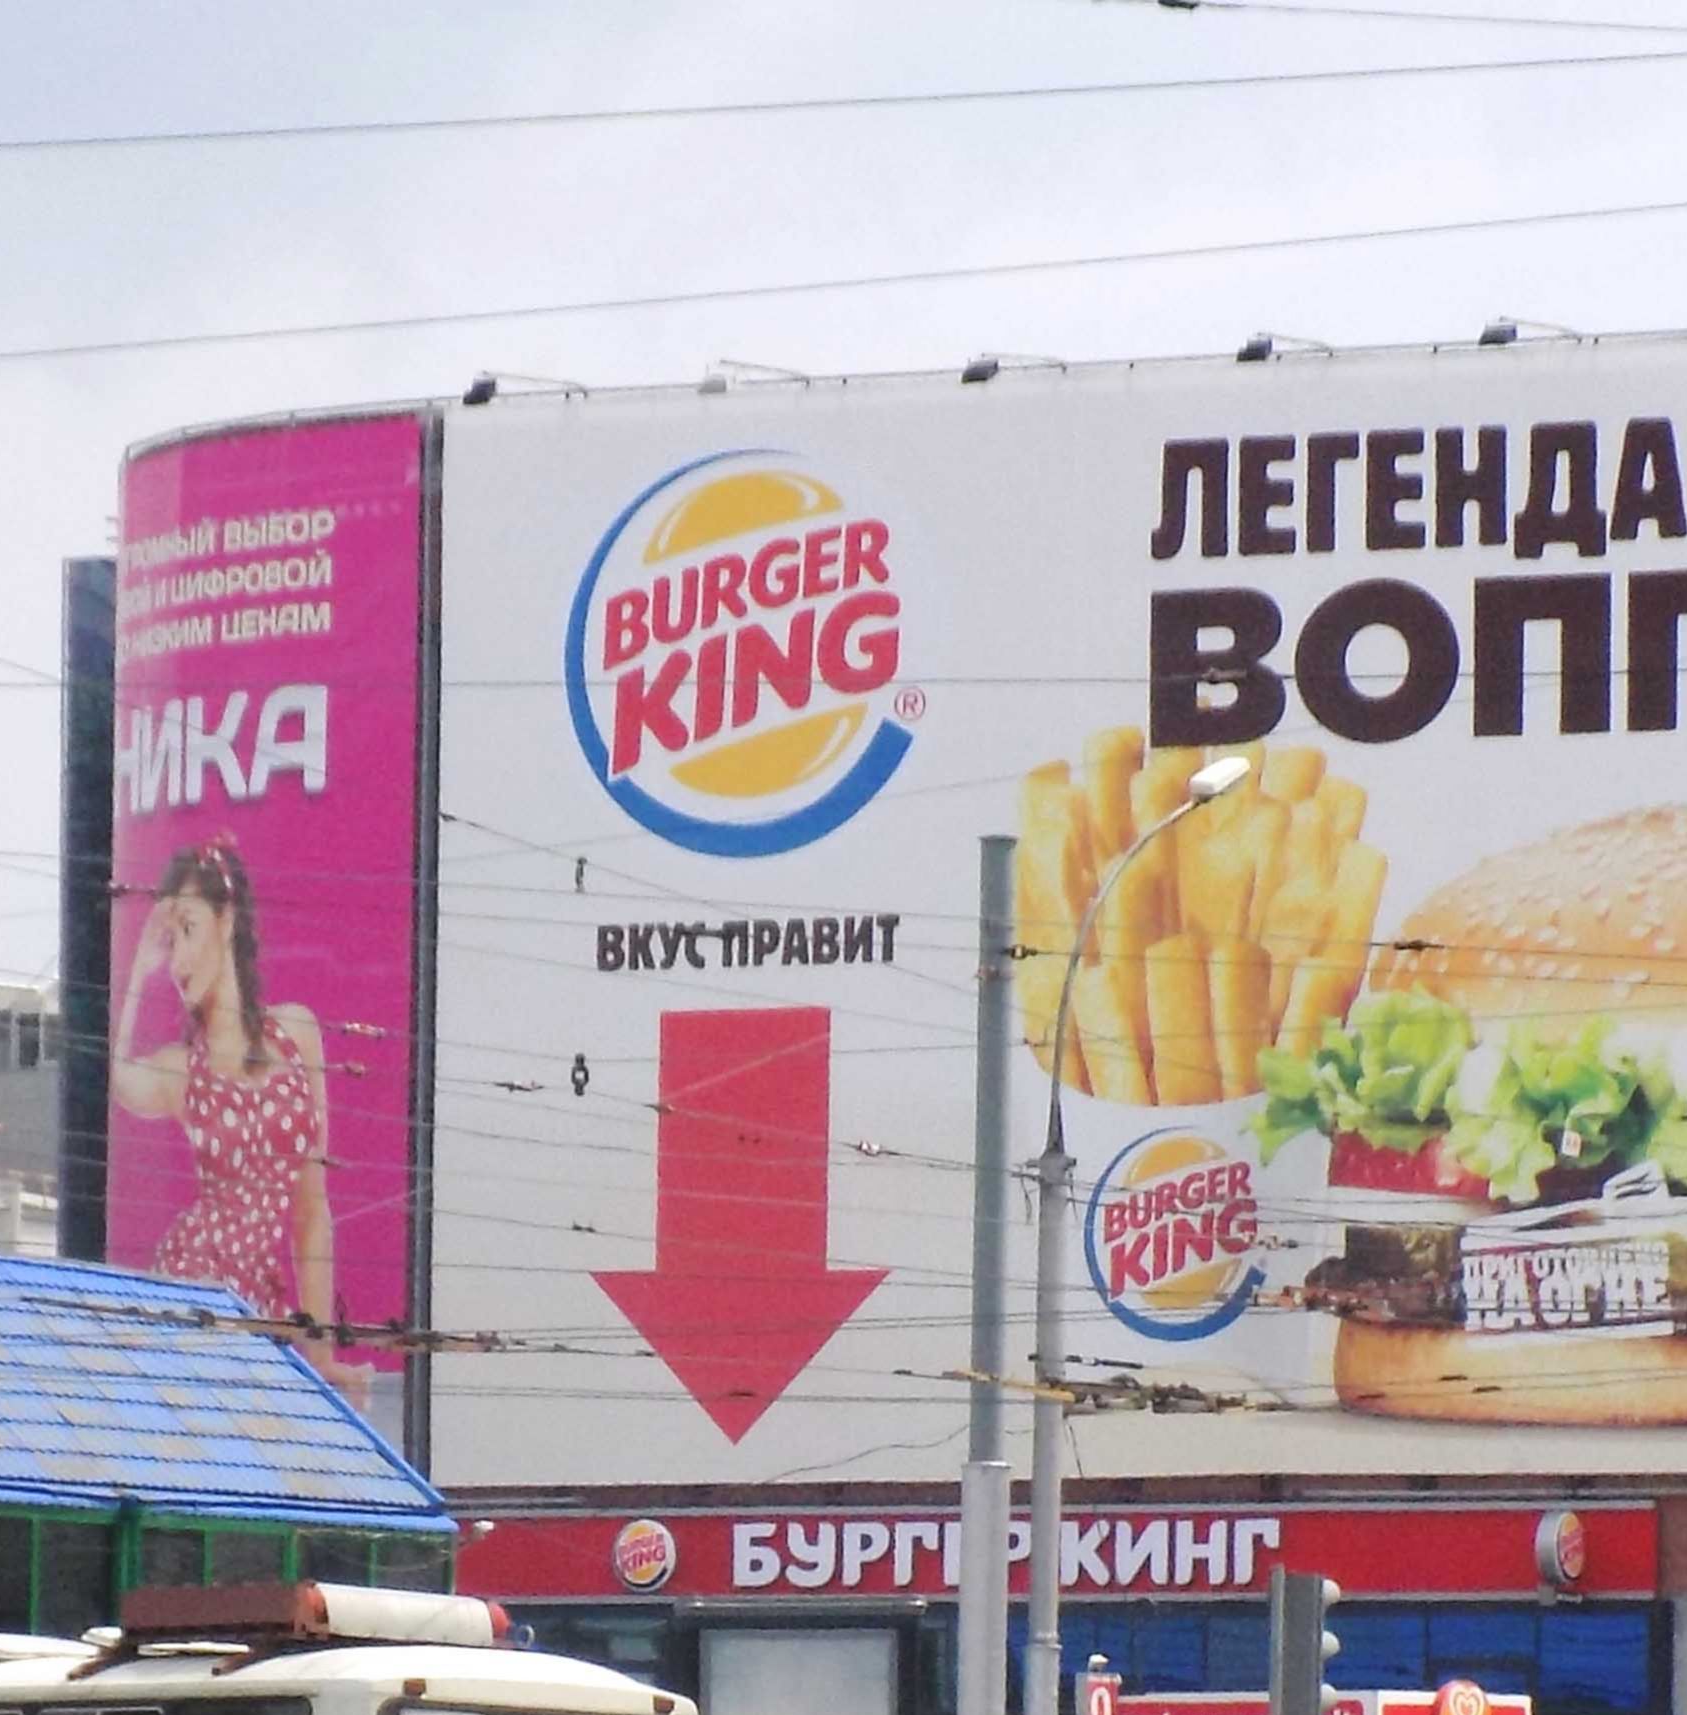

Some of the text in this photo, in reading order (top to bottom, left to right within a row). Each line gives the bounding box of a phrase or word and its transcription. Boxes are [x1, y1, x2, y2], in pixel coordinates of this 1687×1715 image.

[224, 508, 335, 552] ВЫБОР
[170, 547, 332, 606] ЦИФРОВОЙ
[603, 518, 890, 671] BURGER
[221, 601, 332, 644] ЦЕНАМ
[612, 590, 901, 776] KING
[596, 914, 901, 972] ВКУС ПРАВИТ
[1102, 1160, 1252, 1245] BURGER
[1109, 1199, 1258, 1300] KING
[1059, 1518, 1280, 1587] КИНГ
